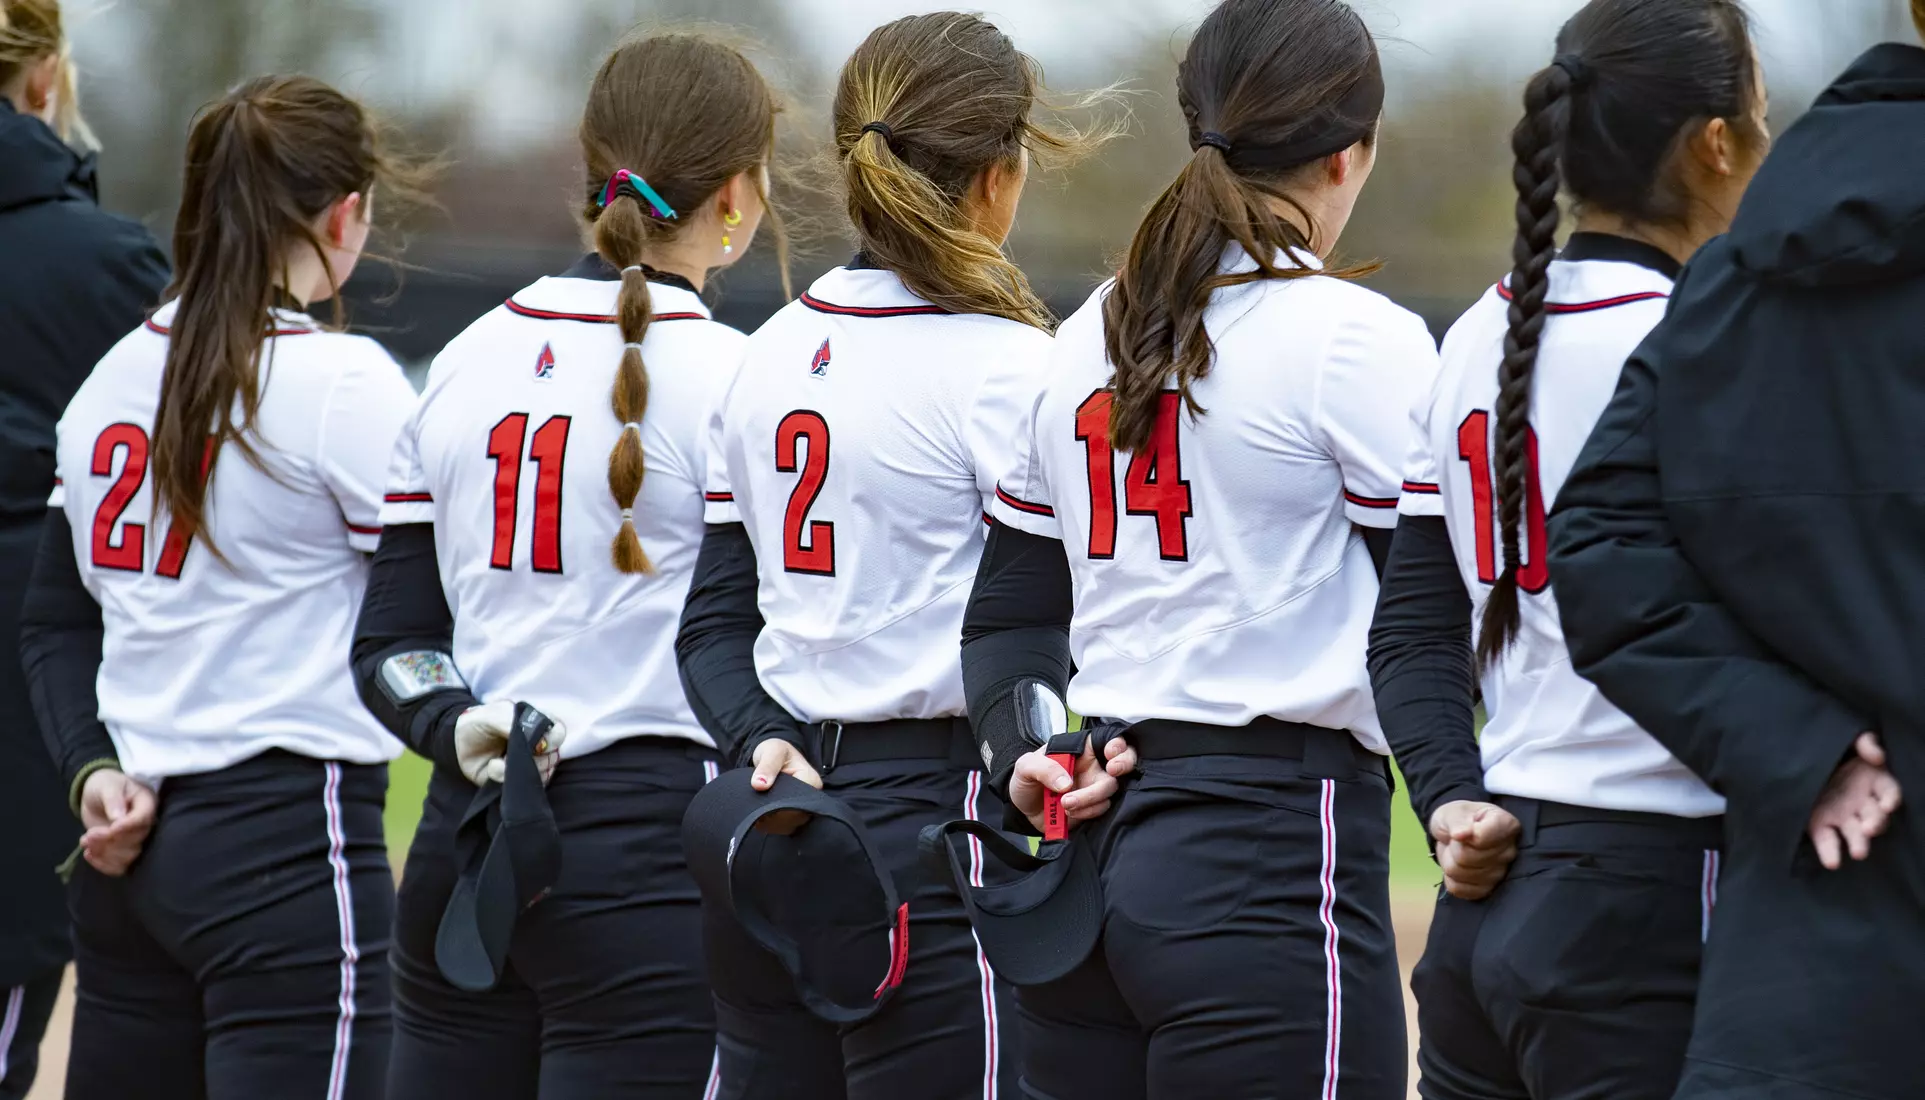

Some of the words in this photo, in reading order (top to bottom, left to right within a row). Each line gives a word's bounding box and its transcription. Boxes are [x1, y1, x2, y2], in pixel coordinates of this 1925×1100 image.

[486, 411, 572, 575] 11
[776, 409, 835, 577] 2
[1075, 388, 1193, 562] 14
